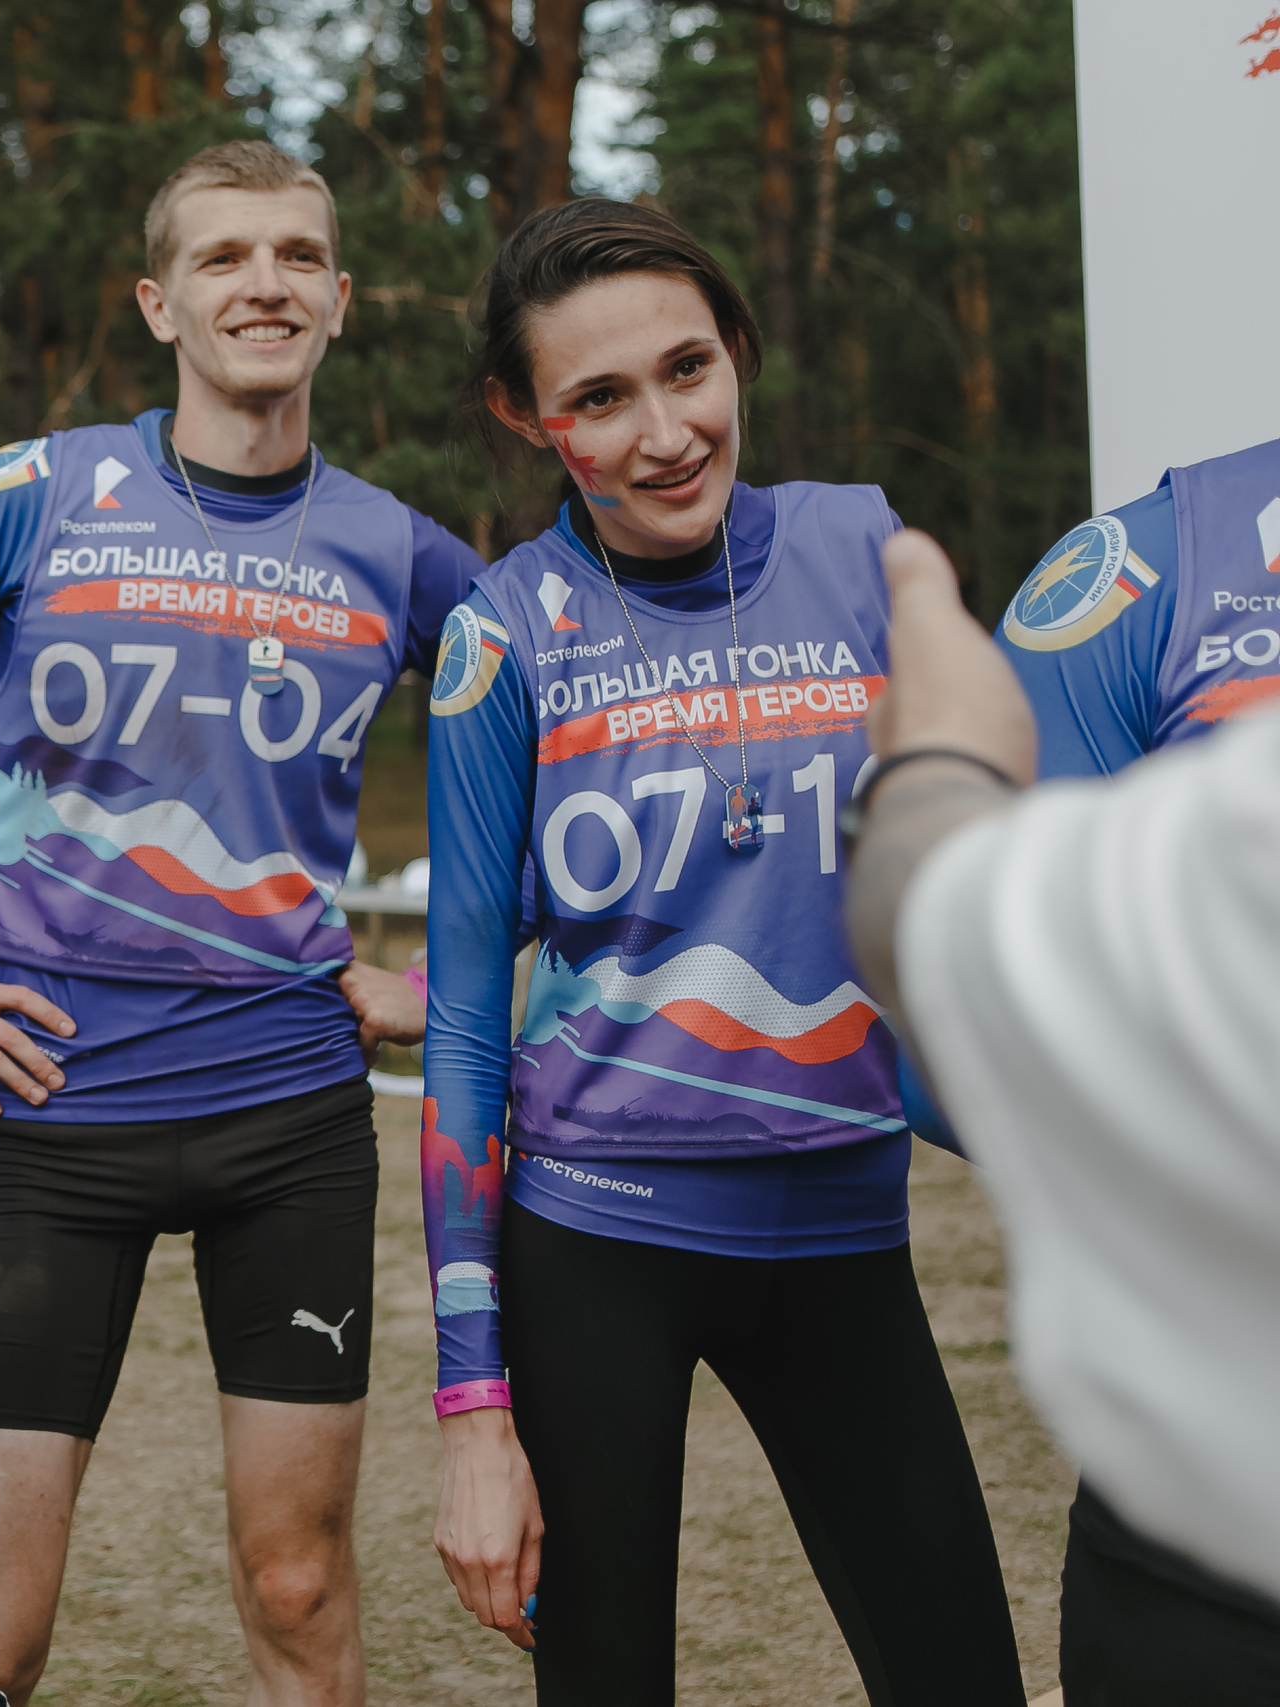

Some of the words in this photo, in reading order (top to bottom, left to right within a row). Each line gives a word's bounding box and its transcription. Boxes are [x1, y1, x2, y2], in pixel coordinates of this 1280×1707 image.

[60, 518, 156, 535] Ростелеком
[48, 547, 227, 577] БОЛЬШАЯ
[236, 553, 350, 605] ГОНКА
[1088, 556, 1117, 602] РОССИИ
[117, 582, 227, 615] ВРЕМЯ
[235, 595, 350, 638] ГЕРОЕВ
[467, 623, 478, 667] РОССИИ
[535, 634, 625, 666] остелеком
[726, 640, 862, 682] ГОНКА
[1195, 628, 1280, 673] БО
[30, 641, 384, 774] 07-04
[606, 691, 728, 743] ВРЕМЯ
[730, 682, 869, 720] ГЕРОЕВ
[542, 753, 880, 913] 07-1
